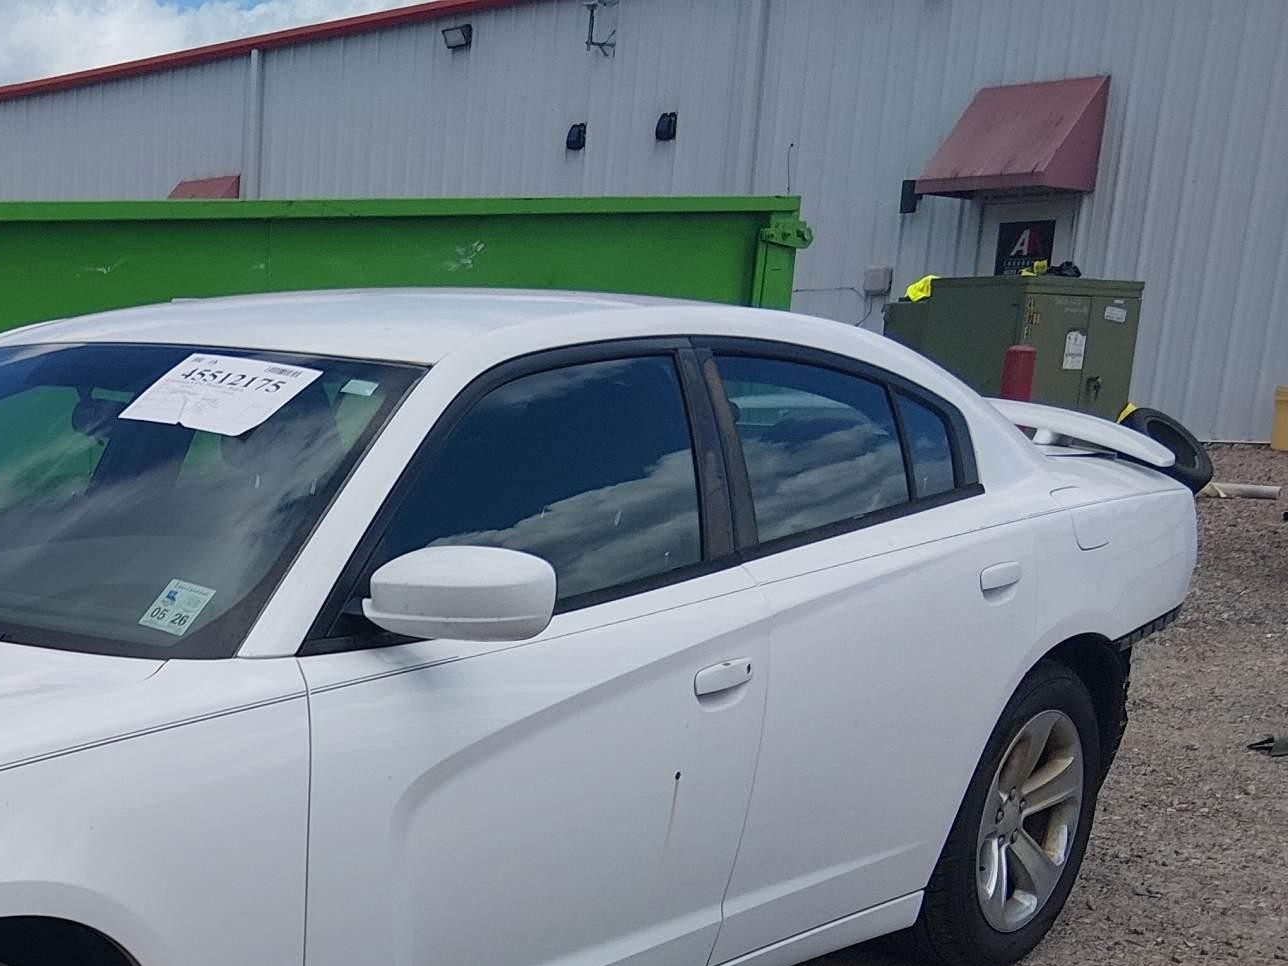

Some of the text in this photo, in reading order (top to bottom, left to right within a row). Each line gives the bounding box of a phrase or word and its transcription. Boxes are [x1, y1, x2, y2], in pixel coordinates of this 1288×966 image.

[181, 367, 287, 393] 45512175
[150, 607, 190, 626] 05 26
